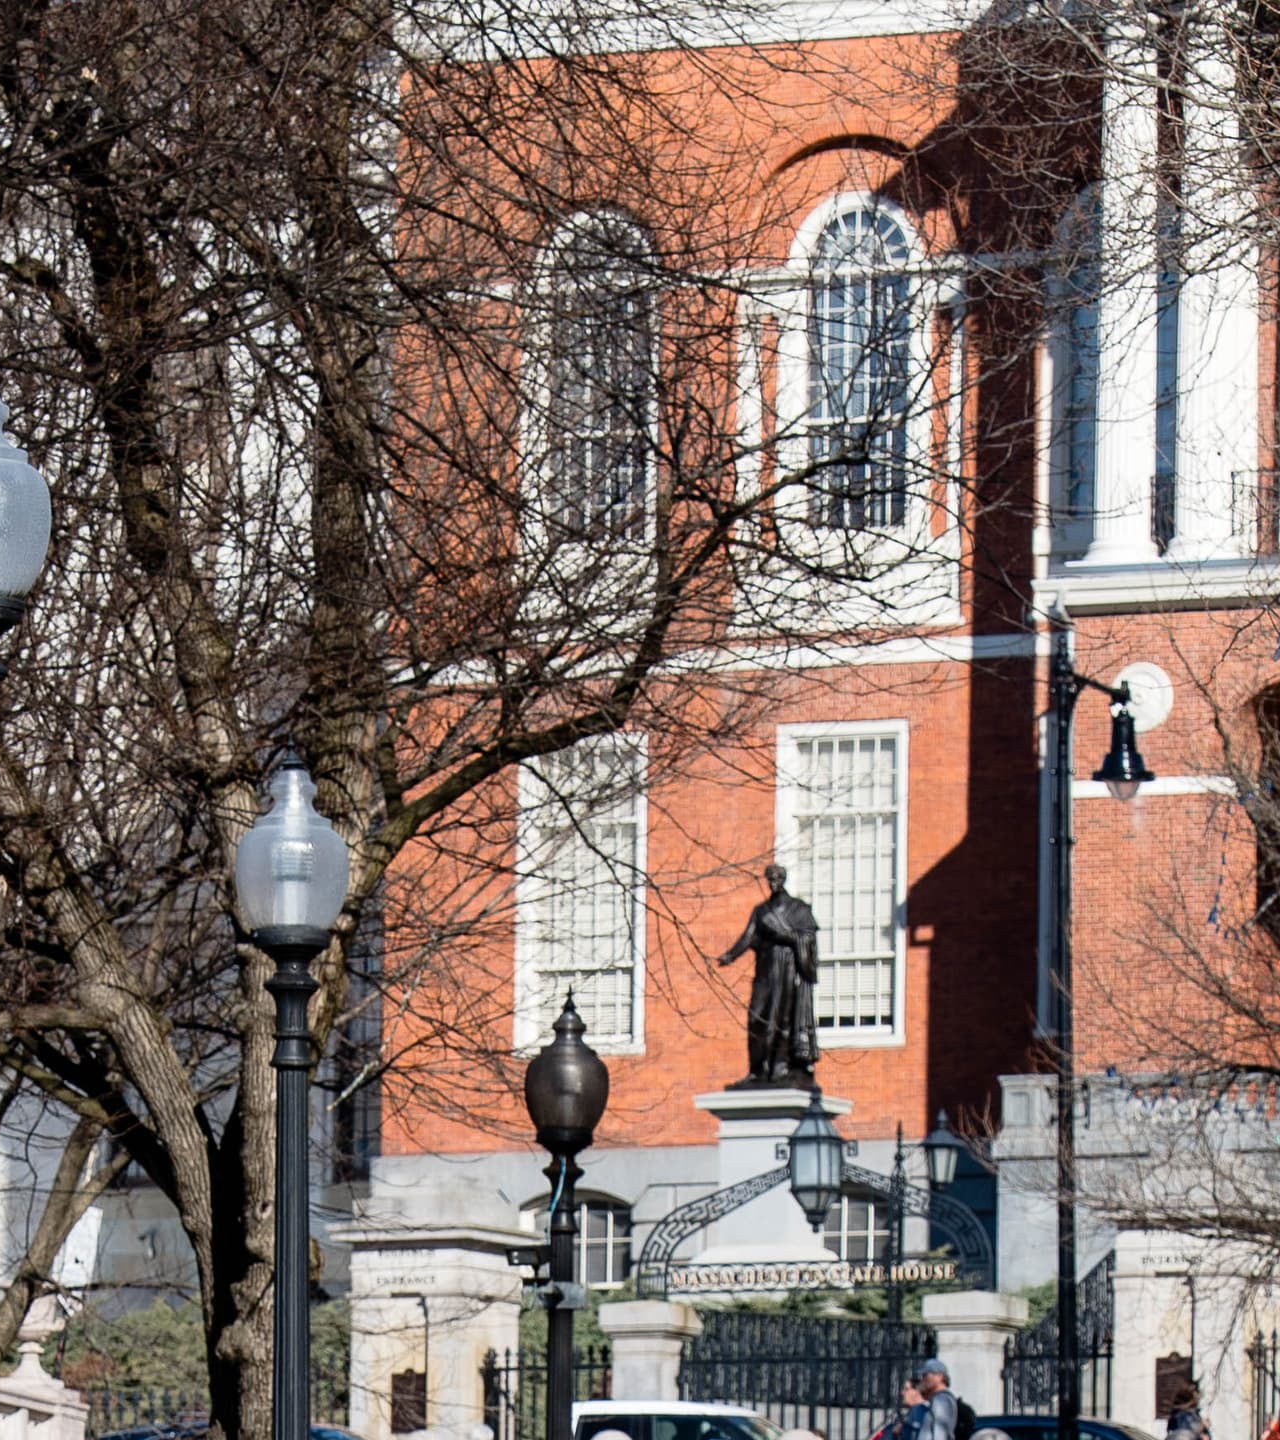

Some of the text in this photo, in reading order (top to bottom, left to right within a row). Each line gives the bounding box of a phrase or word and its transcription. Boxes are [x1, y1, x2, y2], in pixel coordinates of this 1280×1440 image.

[671, 1263, 956, 1289] MASSACHUSETTS STATE HOUSE
